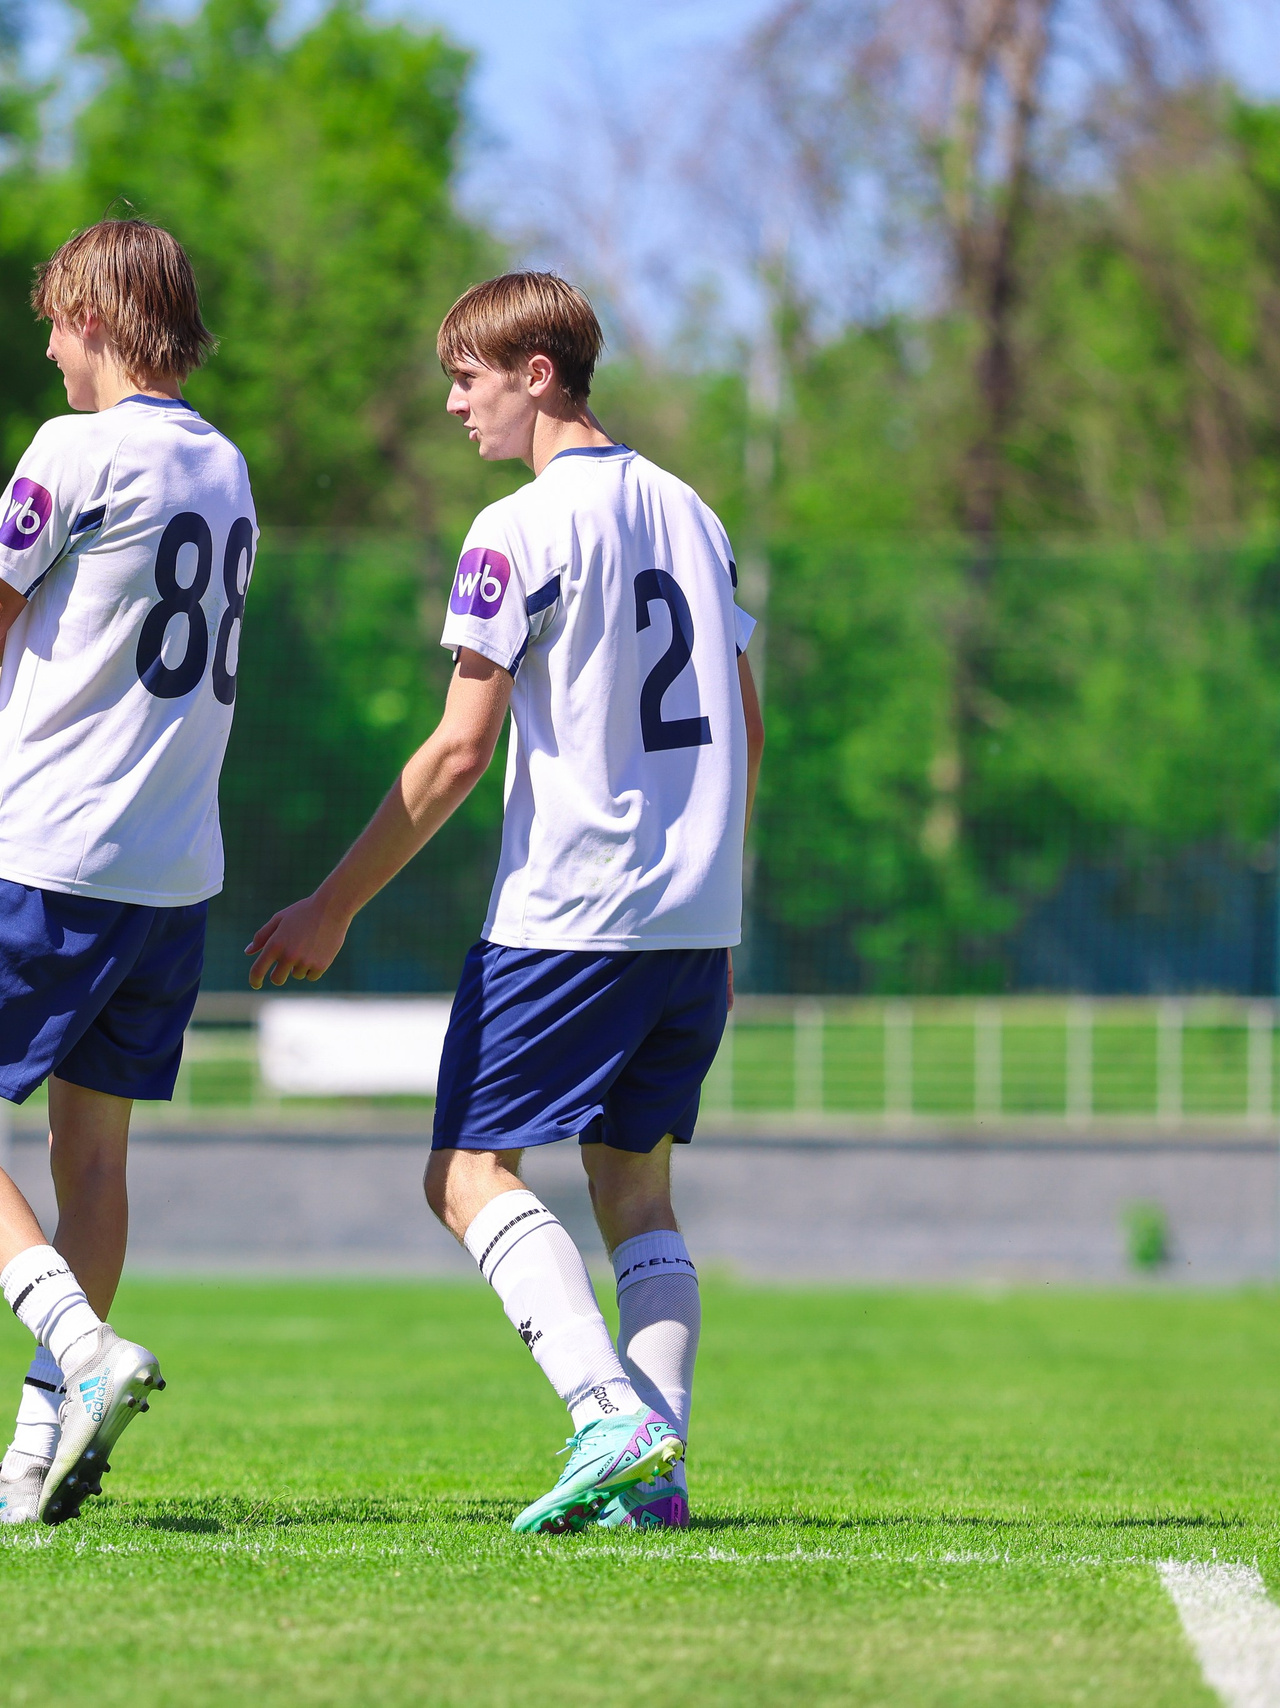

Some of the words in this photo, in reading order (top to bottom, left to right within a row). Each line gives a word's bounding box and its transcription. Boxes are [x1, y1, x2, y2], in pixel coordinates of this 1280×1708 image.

[136, 511, 254, 706] 88
[458, 563, 502, 603] wb
[633, 568, 713, 753] 2
[91, 1366, 111, 1422] adidas
